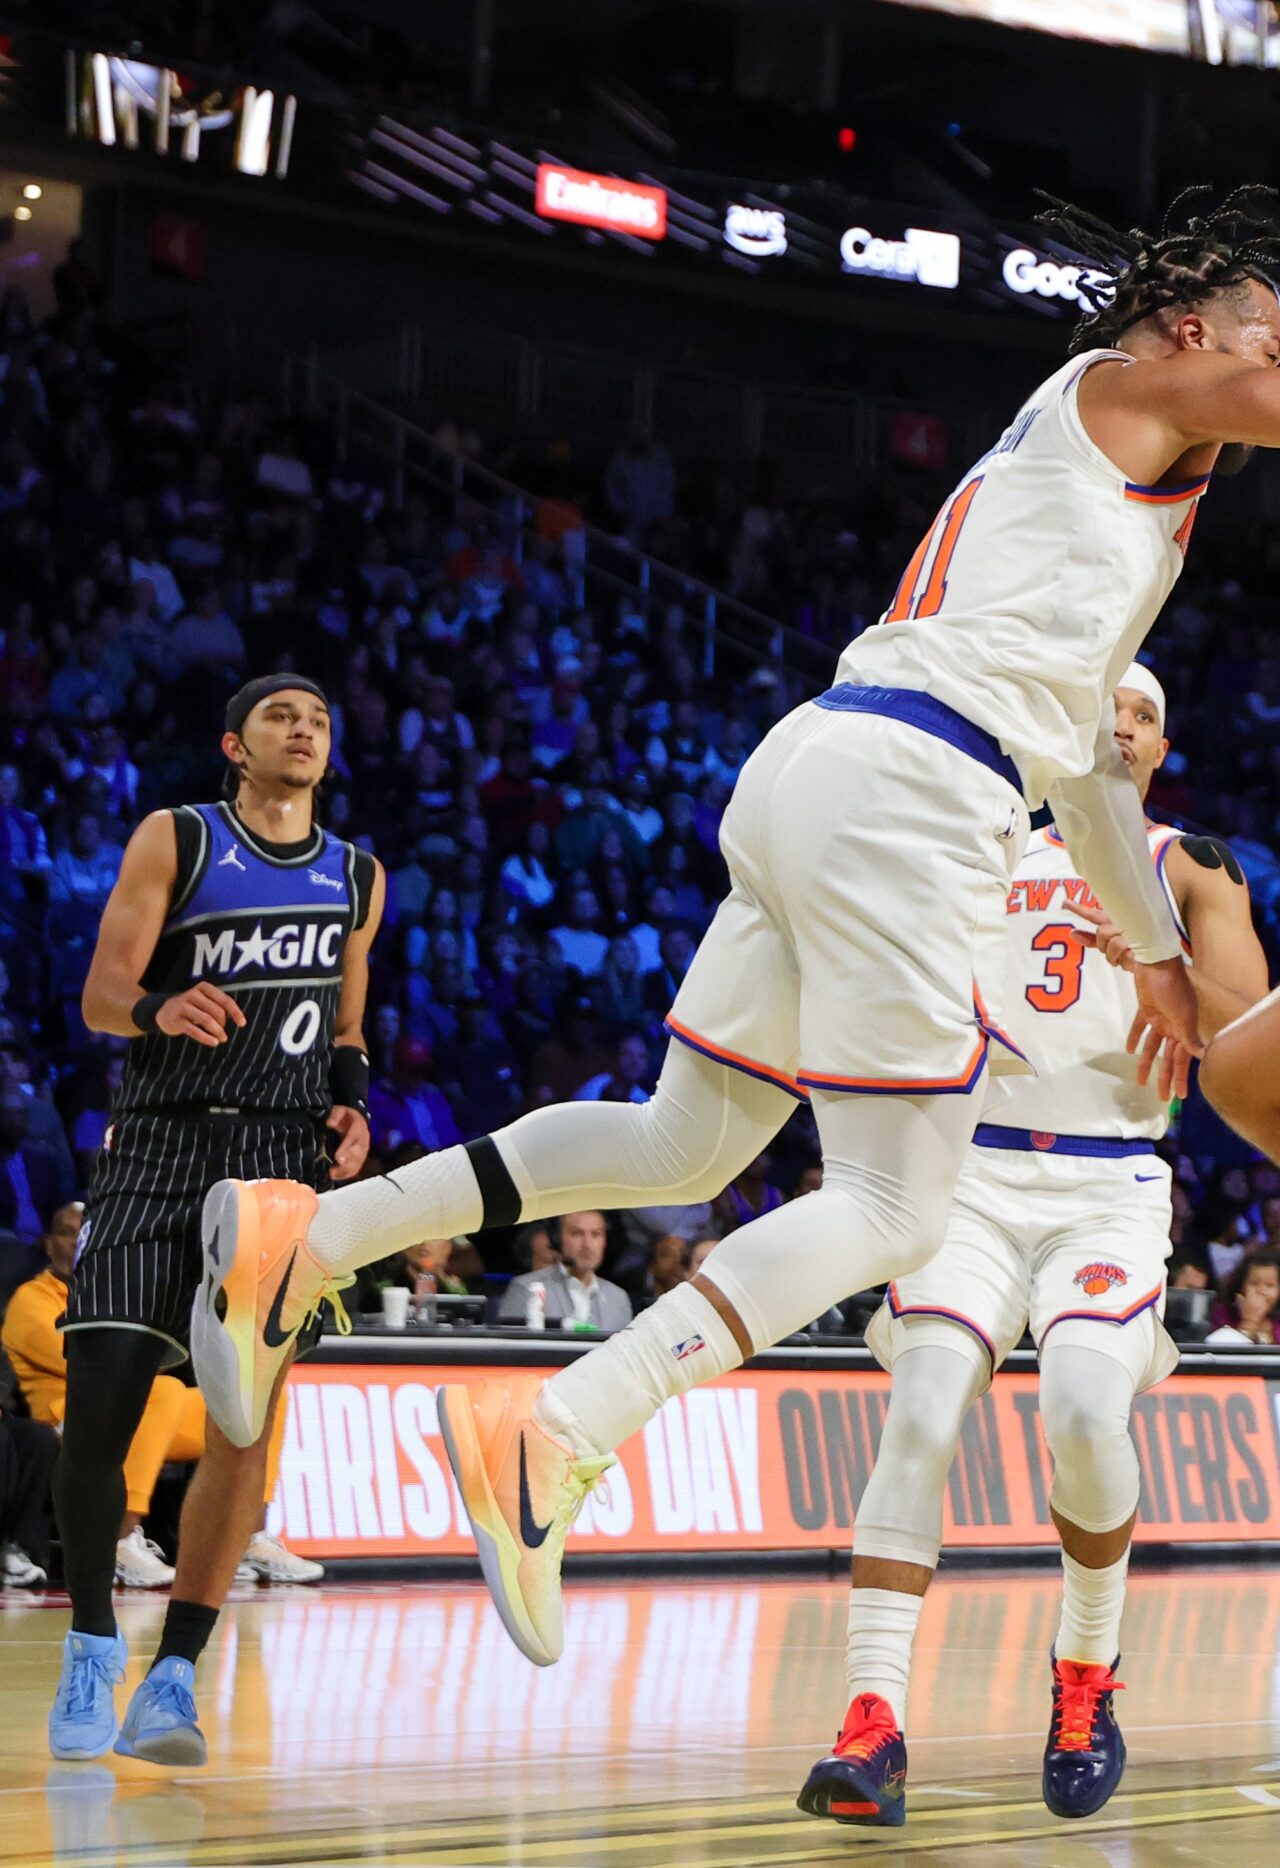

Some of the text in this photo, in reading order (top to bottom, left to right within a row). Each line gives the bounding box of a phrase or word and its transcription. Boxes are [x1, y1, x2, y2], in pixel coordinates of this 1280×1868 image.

[725, 204, 786, 238] aws
[884, 474, 987, 625] 11
[307, 869, 344, 892] Disney
[1006, 879, 1060, 916] EW
[1025, 923, 1085, 1013] 3
[280, 1000, 321, 1055] 0
[642, 1387, 764, 1534] DAY
